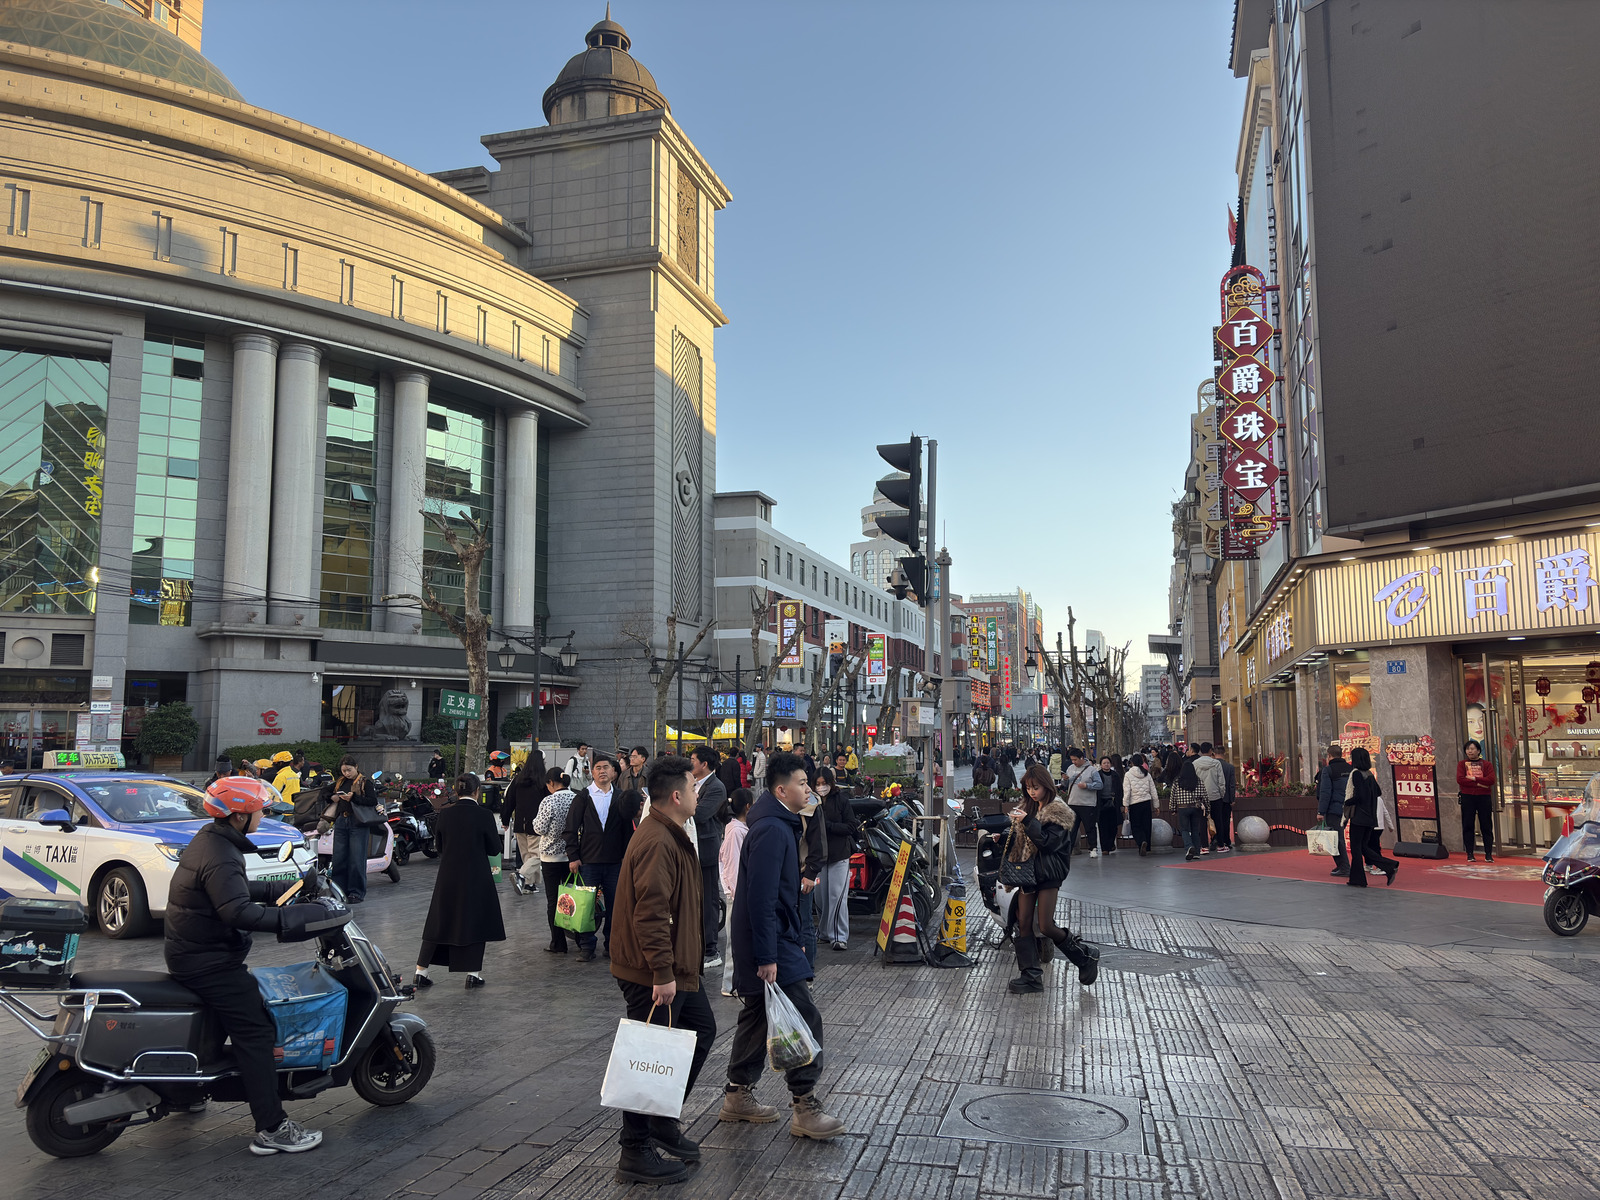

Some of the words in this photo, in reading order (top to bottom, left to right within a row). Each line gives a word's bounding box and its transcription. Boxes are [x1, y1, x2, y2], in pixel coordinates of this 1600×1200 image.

[1228, 316, 1268, 490] 百爵珠宝
[1455, 548, 1598, 619] 百爵
[446, 695, 476, 710] 正义路
[57, 752, 79, 763] 空车
[1398, 782, 1431, 793] 1163
[46, 845, 72, 863] TAXI
